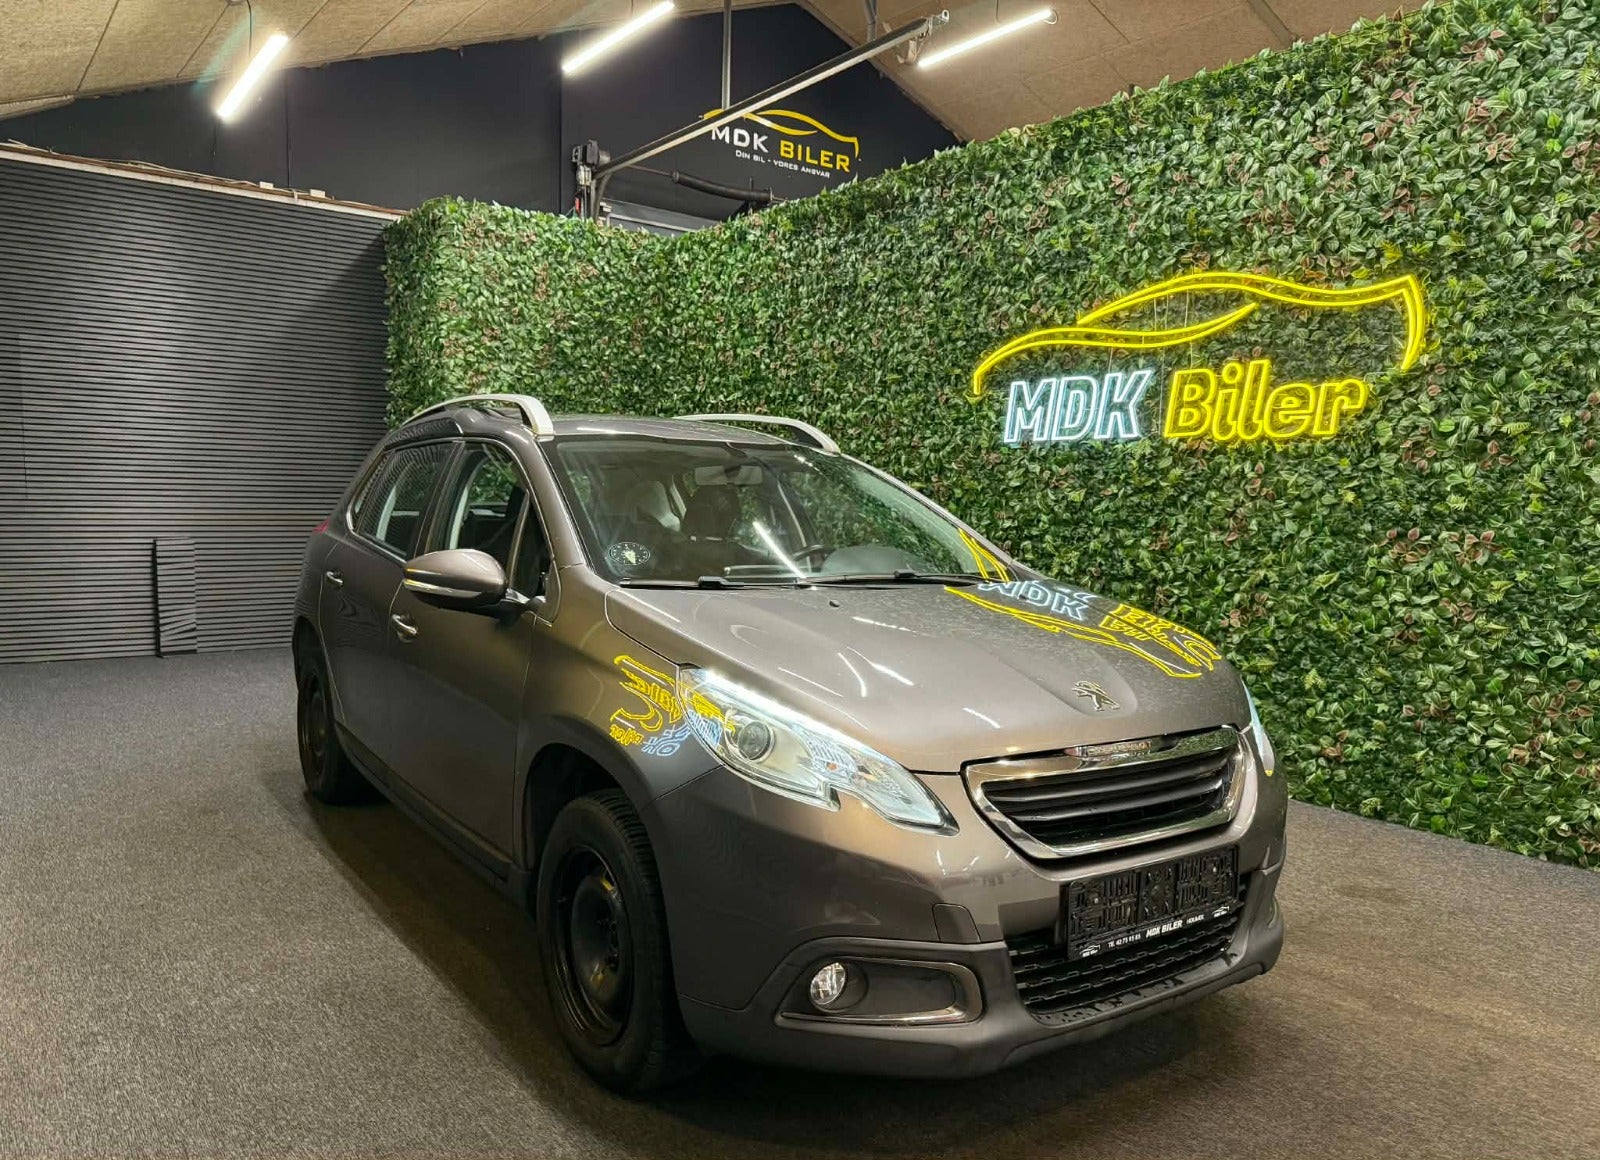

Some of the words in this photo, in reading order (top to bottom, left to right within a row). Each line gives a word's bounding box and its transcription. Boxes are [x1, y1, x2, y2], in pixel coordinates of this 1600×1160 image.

[711, 126, 769, 153] MDK
[779, 140, 850, 172] BILER
[735, 150, 750, 160] DIN
[753, 154, 766, 164] BIL
[773, 159, 798, 171] VORES
[801, 164, 830, 178] ANSVAR
[1003, 368, 1154, 444] MDK
[1163, 358, 1370, 443] Biler
[1161, 920, 1183, 933] BILER
